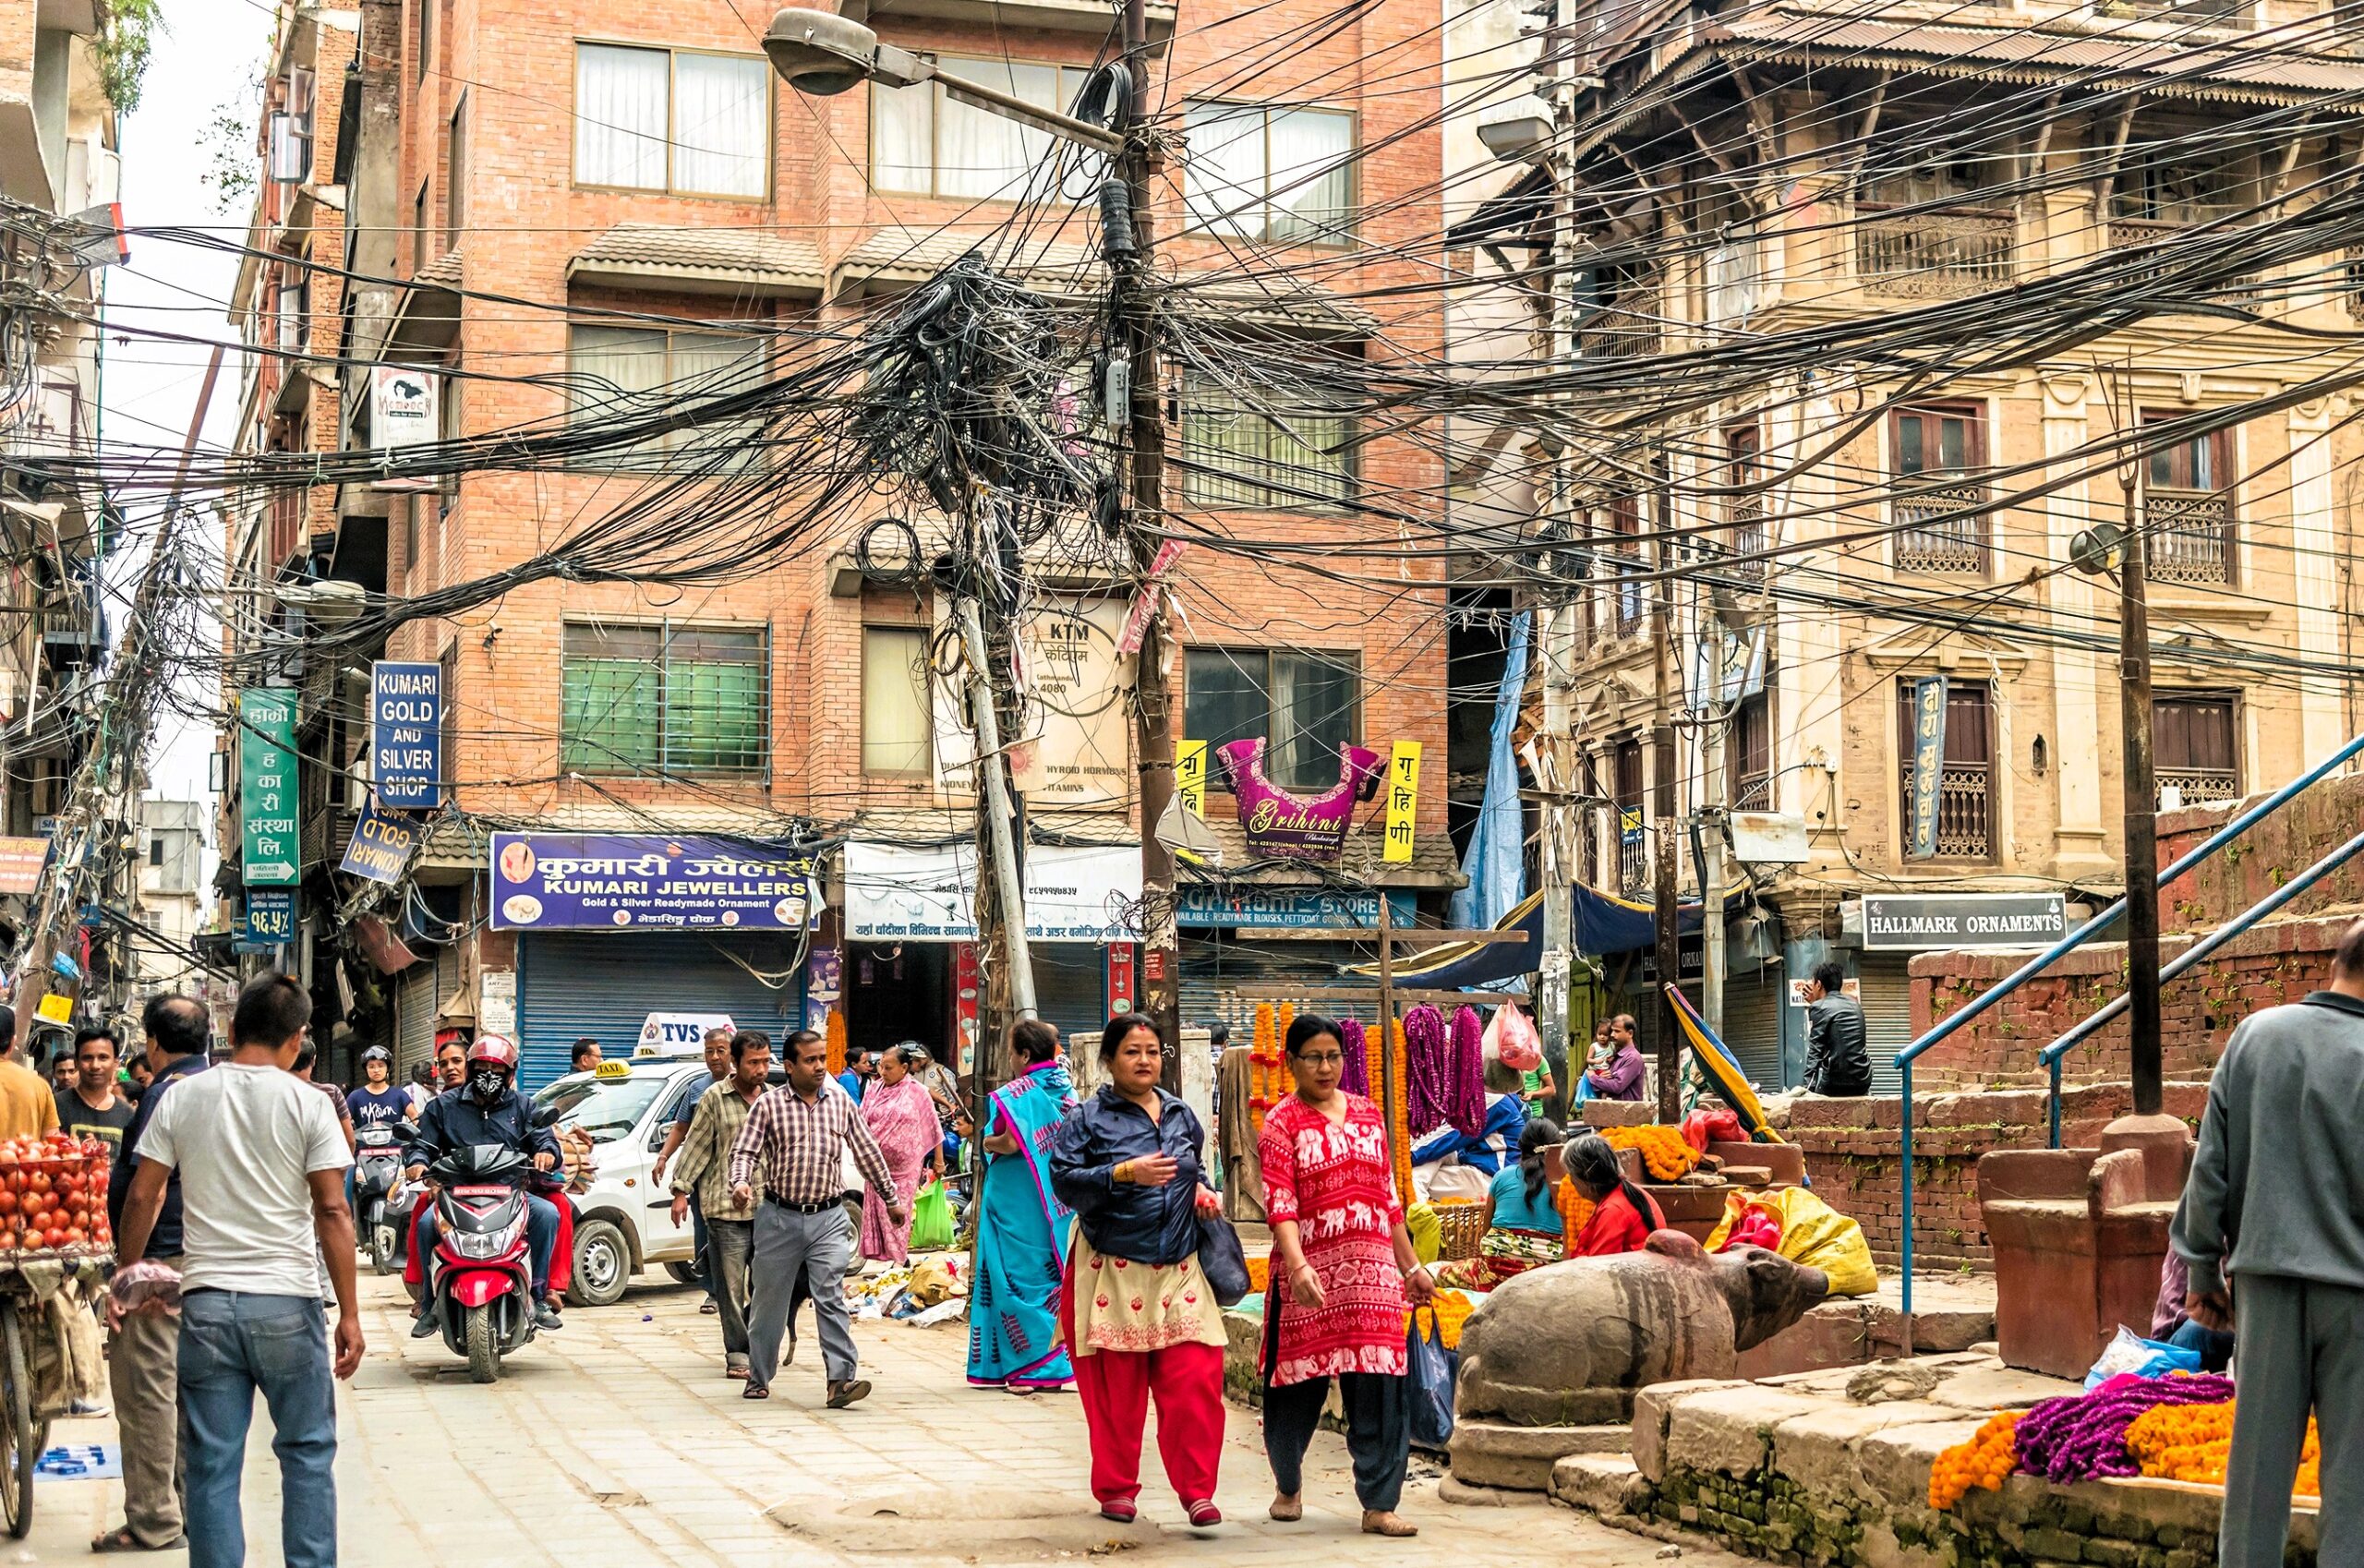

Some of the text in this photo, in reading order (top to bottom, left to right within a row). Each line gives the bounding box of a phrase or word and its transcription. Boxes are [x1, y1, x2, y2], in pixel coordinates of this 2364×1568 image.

[1051, 624, 1088, 640] KTM
[379, 674, 436, 694] KUMARI
[1040, 683, 1067, 694] 4080
[249, 705, 289, 723] हाम्रो
[382, 701, 432, 721] GOLD
[392, 729, 421, 742] AND
[380, 749, 432, 769] SILVER
[385, 776, 428, 796] SHOP
[1249, 799, 1342, 833] Grihini
[247, 817, 294, 834] संस्था
[363, 818, 410, 849] GOLD
[258, 838, 284, 855] लि.
[349, 842, 404, 874] KUMARI
[537, 854, 670, 880] कुमारी
[544, 880, 806, 896] KUMARI JEWELLERS
[582, 898, 769, 911] Gold & Silver Readymade Ornament
[1320, 898, 1377, 914] STORE
[1213, 912, 1252, 923] READYMADE
[1870, 914, 2063, 934] HALLMARK ORNAMENTS
[661, 1023, 700, 1043] TVS
[598, 1064, 619, 1073] TAXI
